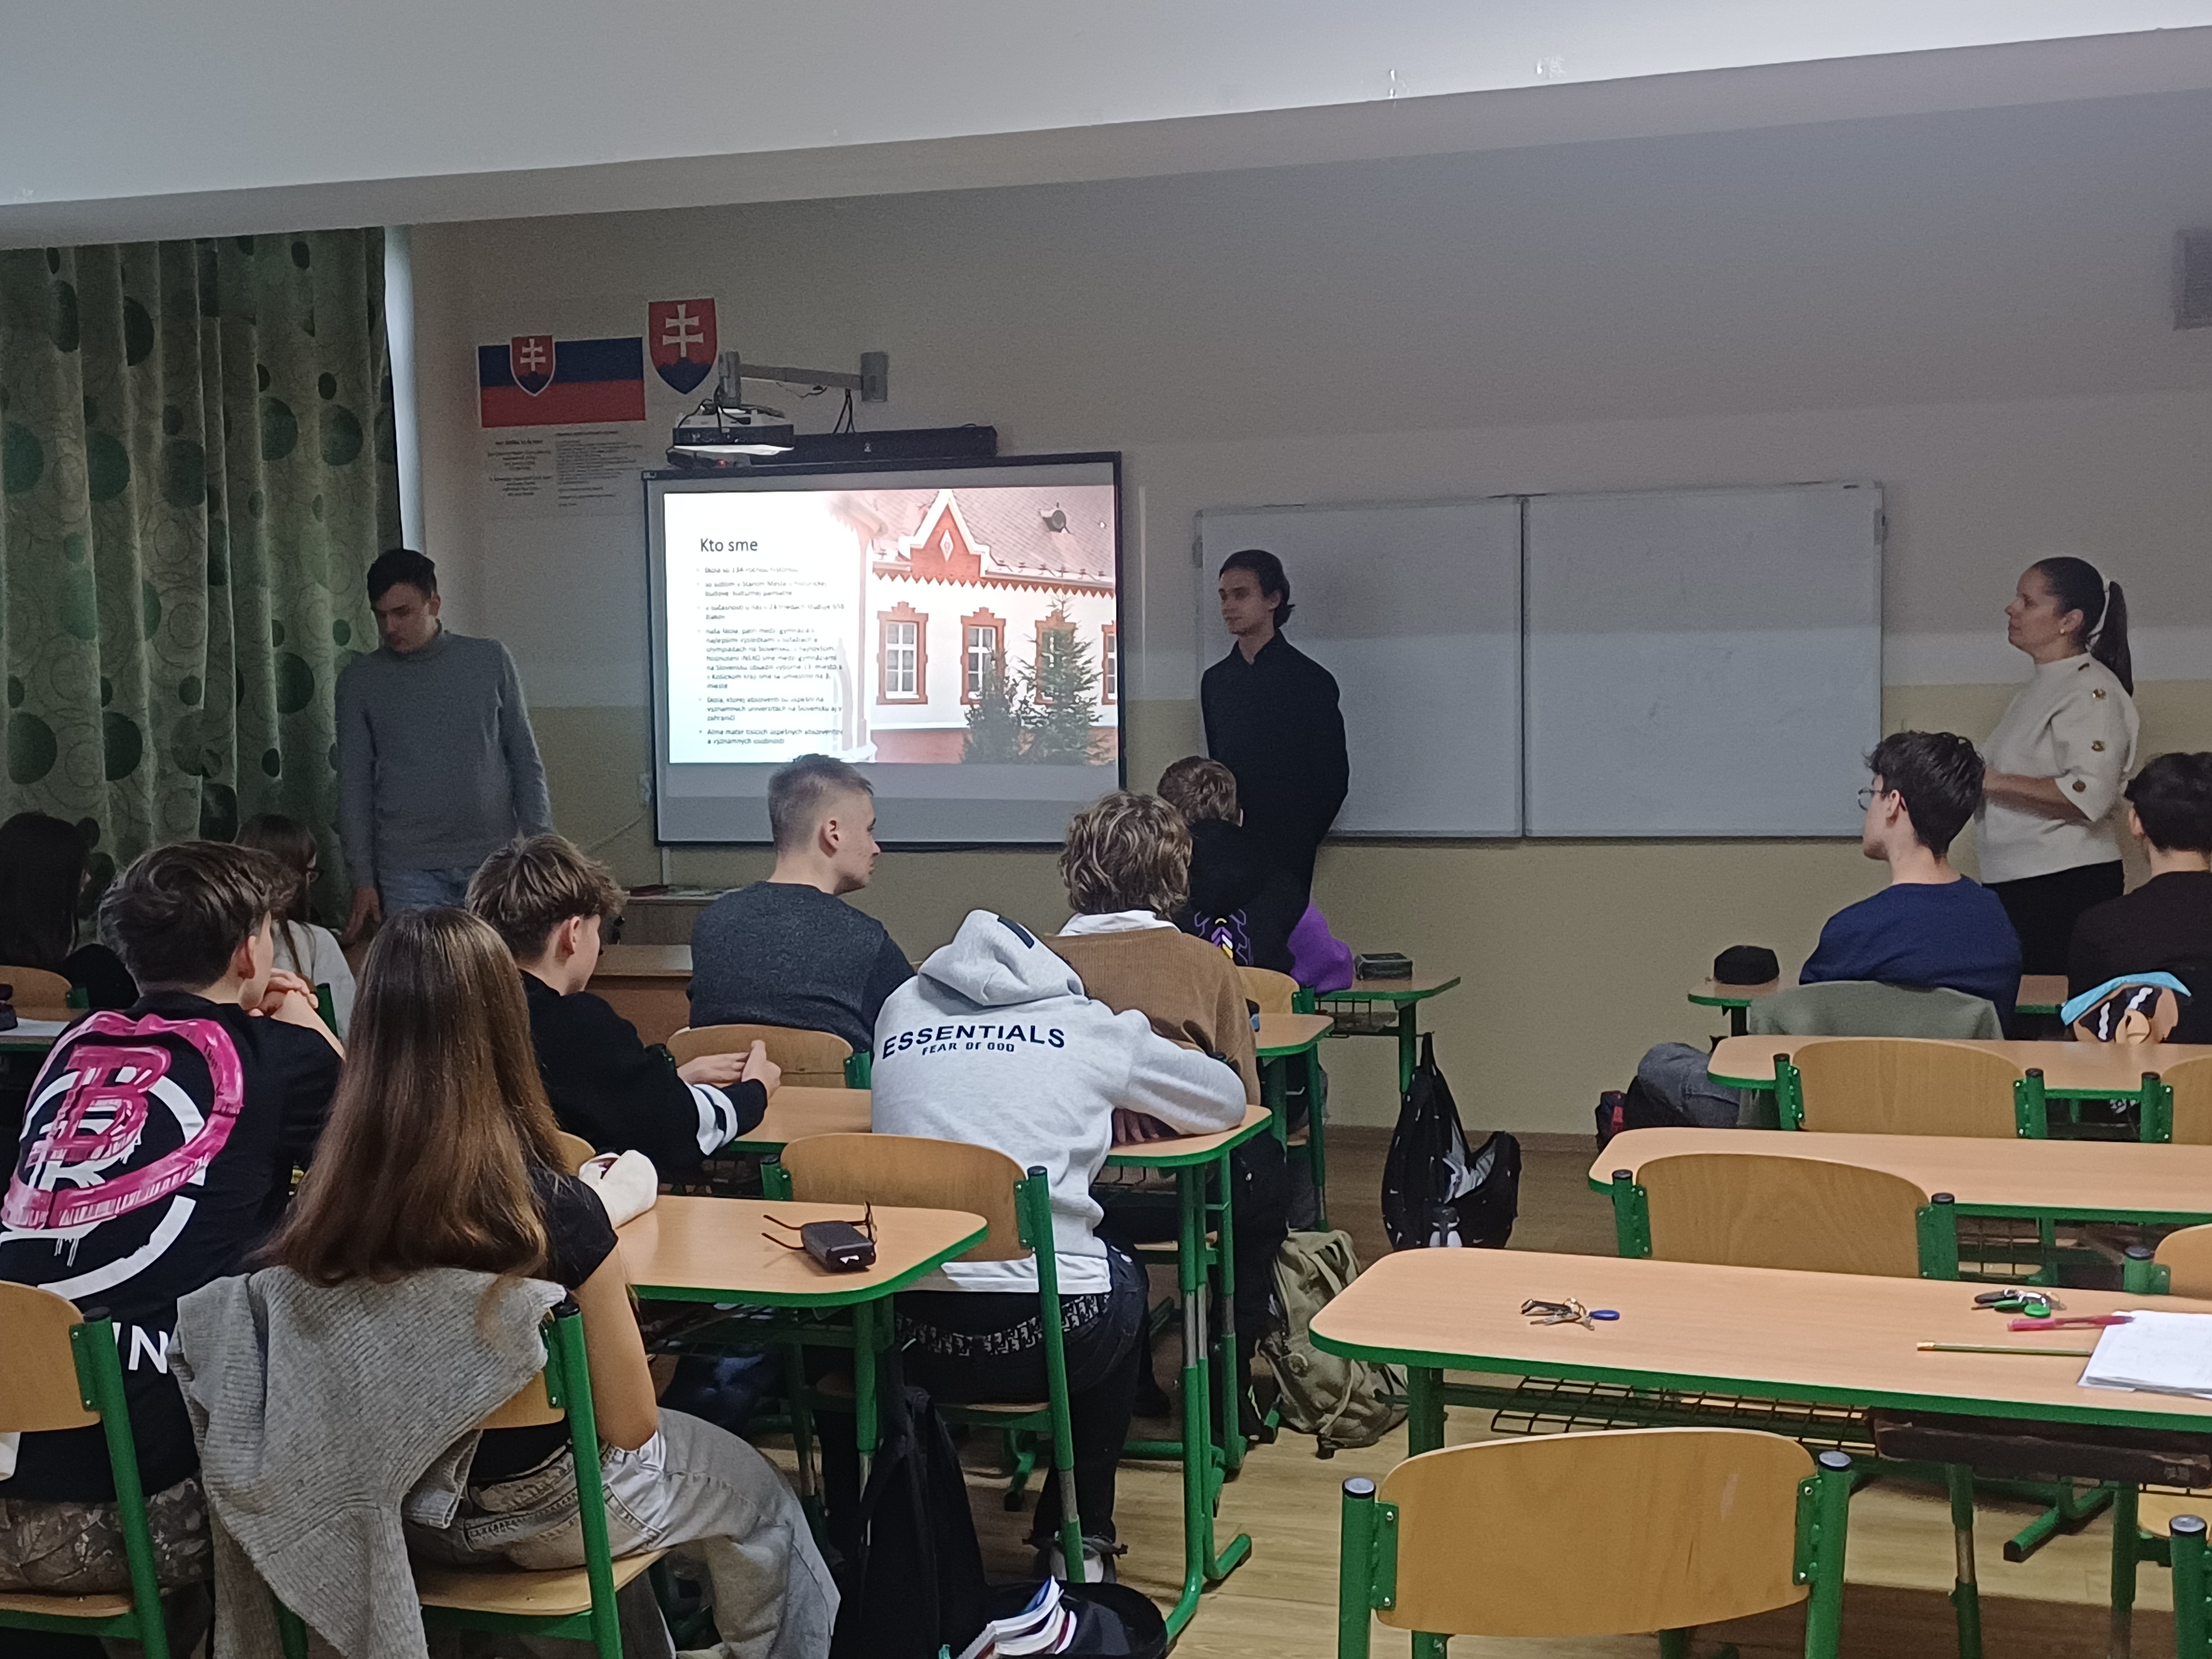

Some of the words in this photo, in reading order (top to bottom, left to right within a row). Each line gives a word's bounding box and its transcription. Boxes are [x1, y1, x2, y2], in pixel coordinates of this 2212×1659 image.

[700, 538, 724, 552] Kto
[728, 540, 758, 552] sme
[882, 1024, 1065, 1060] ESSENTIALS
[921, 1042, 957, 1056] FEAR
[965, 1041, 982, 1050] OF
[987, 1041, 1015, 1053] GOD
